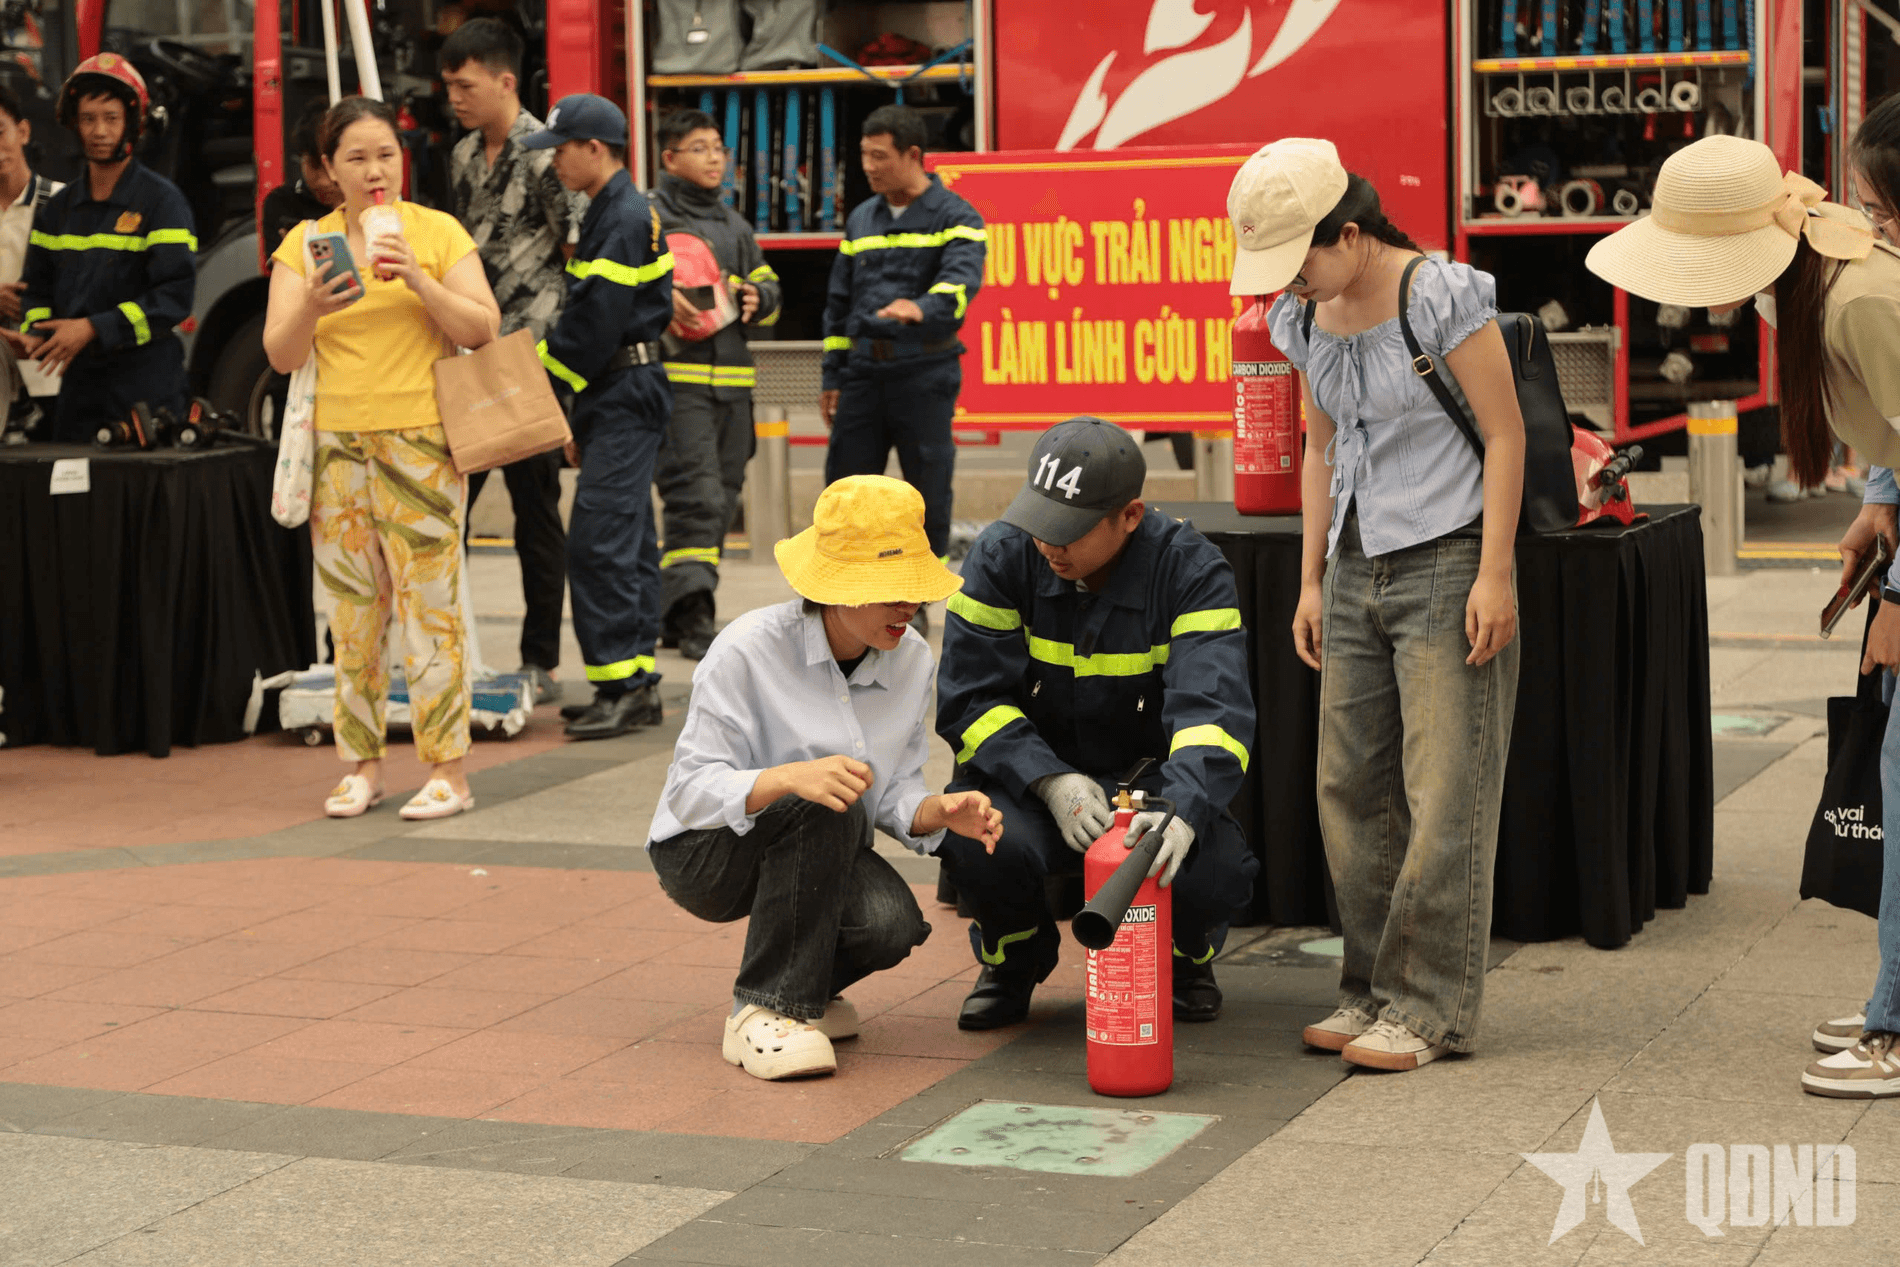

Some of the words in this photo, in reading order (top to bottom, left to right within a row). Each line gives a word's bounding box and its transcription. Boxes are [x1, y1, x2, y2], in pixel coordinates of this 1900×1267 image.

[1022, 215, 1085, 300] VỰC
[1090, 198, 1161, 285] TRẢI
[1168, 217, 1237, 283] NGH
[981, 307, 1049, 384] LÀM
[1054, 306, 1127, 384] LÍNH
[1134, 305, 1197, 384] CỨU
[1258, 362, 1291, 375] DIOXIDE
[1033, 452, 1083, 500] 114
[1837, 804, 1865, 821] vai
[1851, 823, 1885, 840] thá
[1122, 907, 1155, 923] OXIDE
